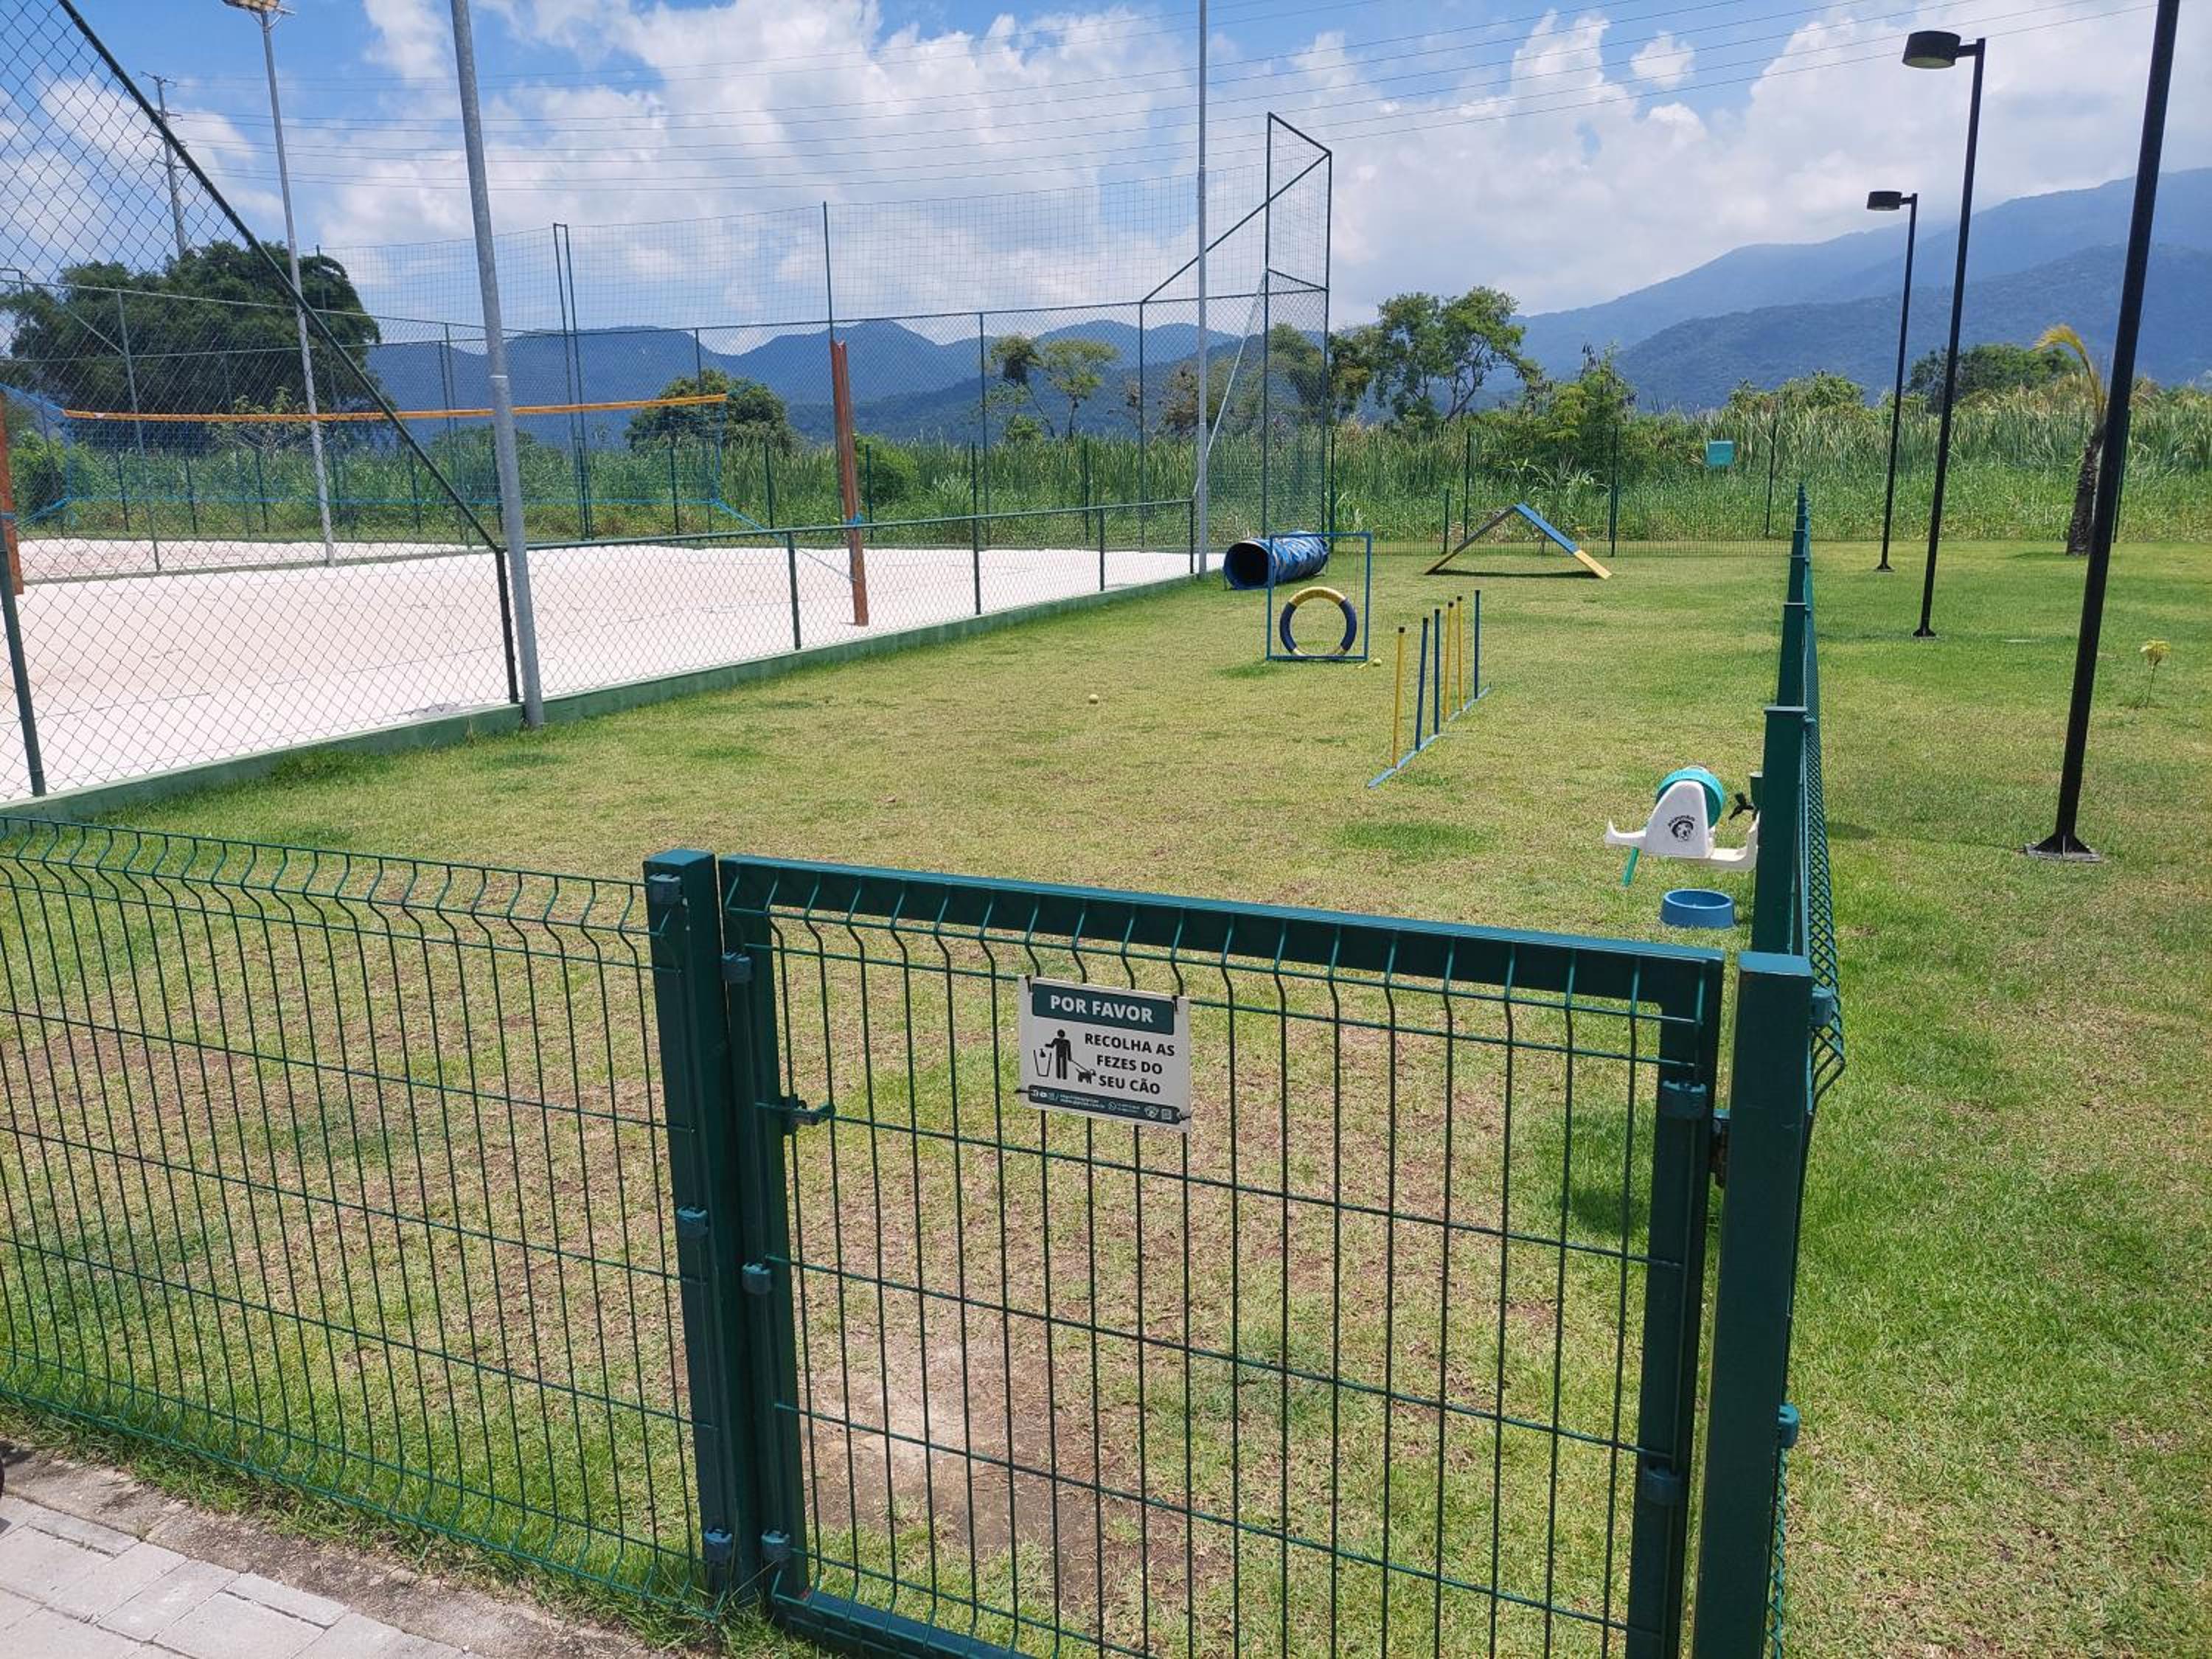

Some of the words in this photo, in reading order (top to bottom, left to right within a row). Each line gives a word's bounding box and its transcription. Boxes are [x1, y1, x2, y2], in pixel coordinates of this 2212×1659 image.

[1050, 995, 1087, 1015] POR
[1092, 1001, 1154, 1023] FAVOR
[1085, 1033, 1152, 1054] RECOLHA
[1155, 1043, 1175, 1057] AS
[1096, 1054, 1136, 1071] FEZES
[1141, 1061, 1163, 1075] DO
[1098, 1074, 1125, 1090] SEU
[1130, 1079, 1161, 1095] CÃO
